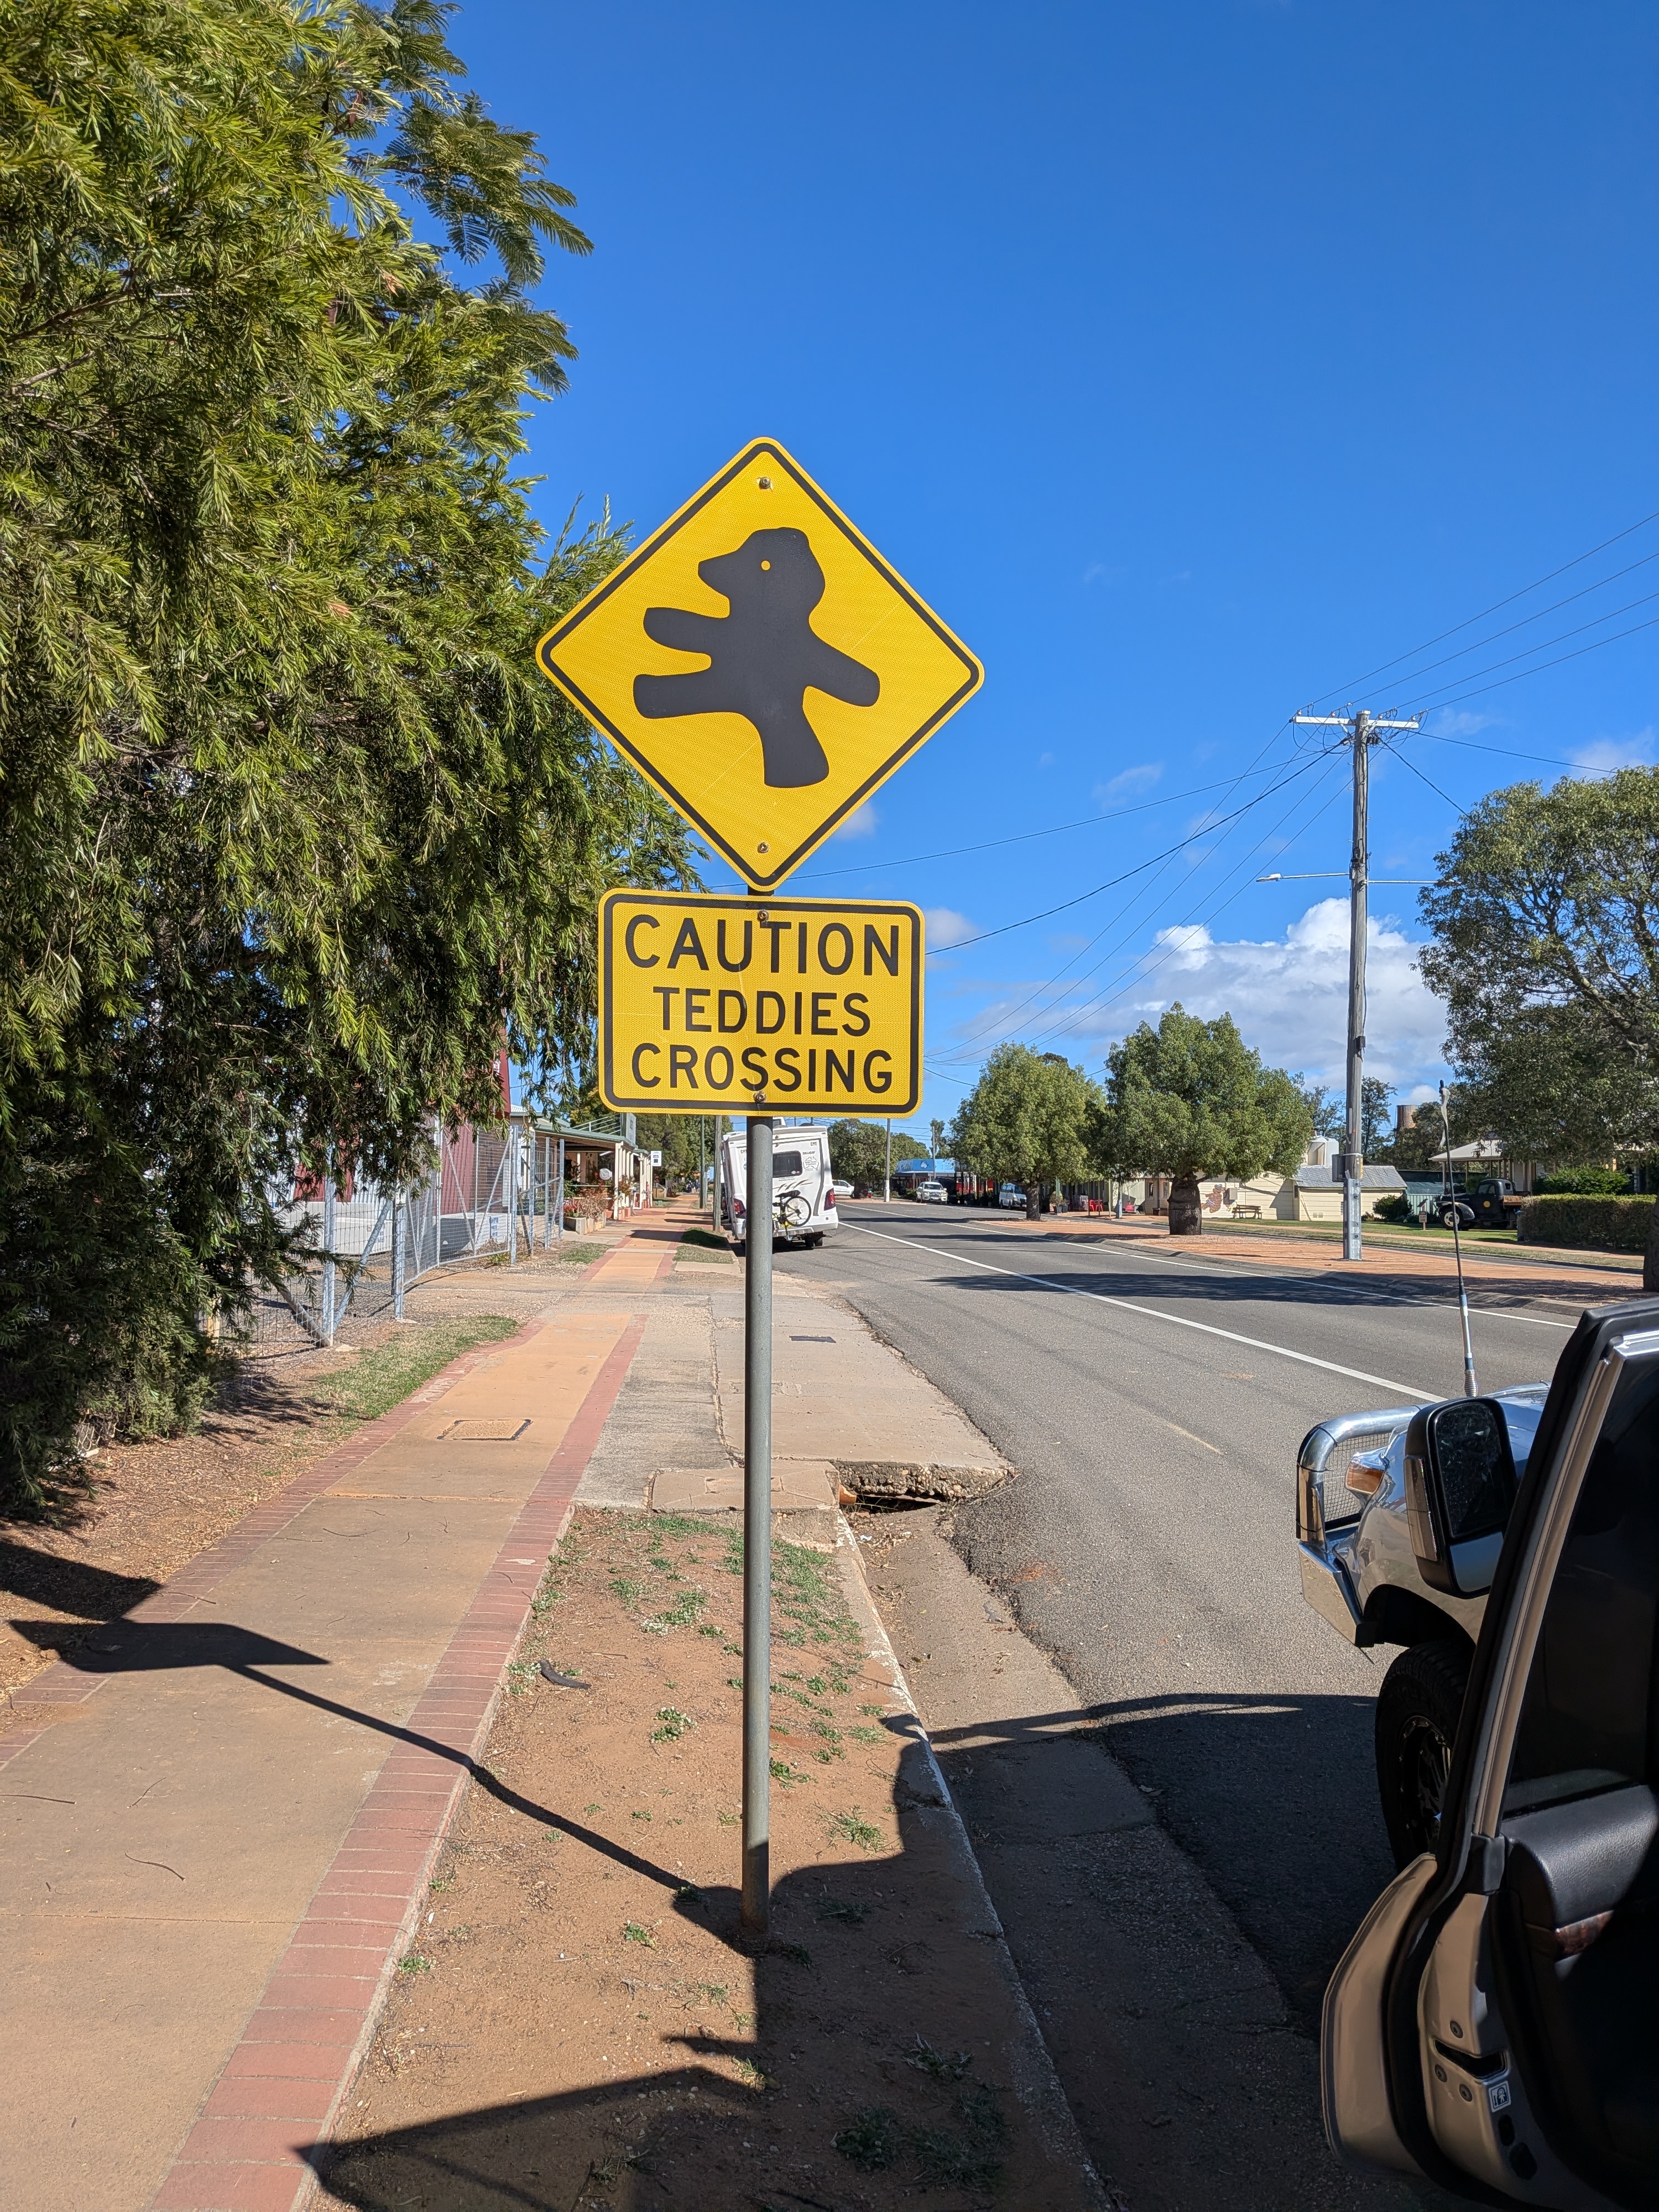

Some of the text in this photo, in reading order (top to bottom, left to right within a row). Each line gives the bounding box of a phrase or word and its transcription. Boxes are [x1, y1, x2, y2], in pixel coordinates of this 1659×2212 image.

[625, 914, 899, 977] CAUTION
[653, 986, 870, 1037] TEDDIES
[632, 1042, 893, 1094] CROSSING
